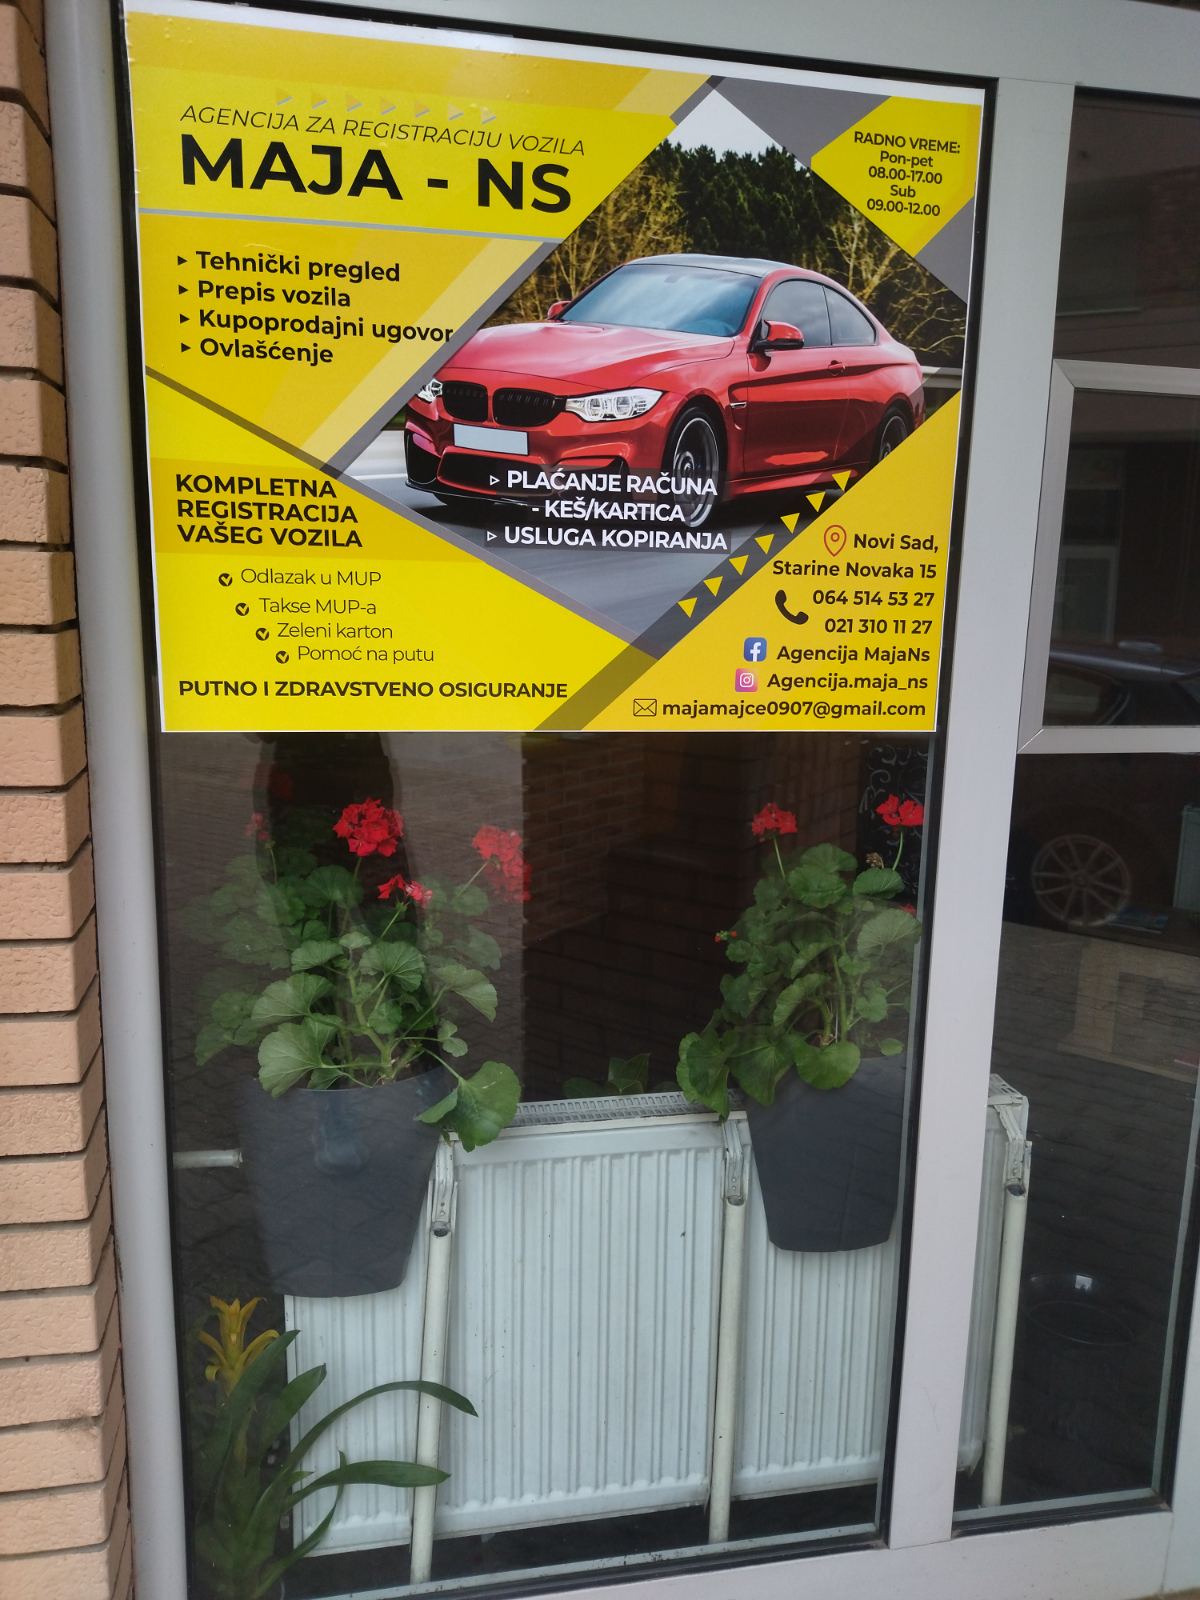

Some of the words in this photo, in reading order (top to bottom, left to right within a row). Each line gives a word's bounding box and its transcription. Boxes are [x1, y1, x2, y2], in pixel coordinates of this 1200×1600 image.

[180, 105, 299, 132] AGENCIJA
[306, 116, 335, 134] ZA
[343, 119, 502, 148] REGISTRACIJU
[509, 133, 585, 156] VOZILA
[854, 131, 906, 148] RADNO
[909, 137, 960, 154] VREME:
[880, 151, 933, 168] Pon-pet
[180, 134, 403, 200] MAJA
[477, 158, 572, 213] NS
[868, 166, 942, 184] 08.00-17.00
[890, 185, 916, 198] Sub
[867, 199, 940, 216] 09.00-12.00
[196, 251, 300, 276] Tehnički
[308, 261, 400, 284] pregled
[197, 280, 275, 306] Prepis
[282, 285, 351, 307] vozila
[199, 309, 364, 340] Kupoprodajni
[372, 324, 454, 344] ugovor
[200, 338, 333, 365] Ovlašćenje
[176, 474, 336, 498] KOMPLETNA
[507, 468, 622, 494] PLAĆANJE
[626, 472, 718, 496] RAČUNA
[177, 499, 358, 524] REGISTRACIJA
[544, 499, 685, 523] KEŠ/KARTICA
[178, 522, 263, 544] VAŠEG
[270, 527, 363, 548] VOZILA
[504, 527, 596, 547] USLUGA
[601, 530, 728, 551] KOPIRANJA
[853, 533, 894, 549] Novi
[900, 535, 939, 554] Sad,
[240, 568, 316, 585] Odlazak
[320, 574, 332, 585] u
[337, 570, 381, 586] MUP
[773, 560, 840, 577] Starine
[845, 562, 914, 578] Novaka
[919, 563, 937, 579] 15
[258, 598, 311, 613] Takse
[316, 599, 377, 615] MUP-a
[812, 590, 848, 606] 064
[853, 590, 884, 606] 514
[887, 591, 909, 607] 53
[913, 592, 935, 608] 27
[277, 623, 332, 638] Zeleni
[337, 623, 393, 639] karton
[824, 618, 853, 633] 021
[858, 618, 888, 634] 310
[894, 620, 907, 634] 11
[911, 620, 932, 634] 27
[298, 646, 362, 662] Pomoć
[367, 650, 388, 662] na
[393, 649, 434, 665] putu
[777, 645, 859, 665] Agencija
[863, 647, 930, 665] MajaNs
[179, 680, 257, 696] PUTNO
[264, 682, 268, 696] I
[275, 681, 434, 698] ZDRAVSTVENO
[438, 682, 568, 698] OSIGURANJE
[767, 673, 928, 692] Agencija.maja_ns
[662, 699, 926, 719] majamajce0907@gmail.com
